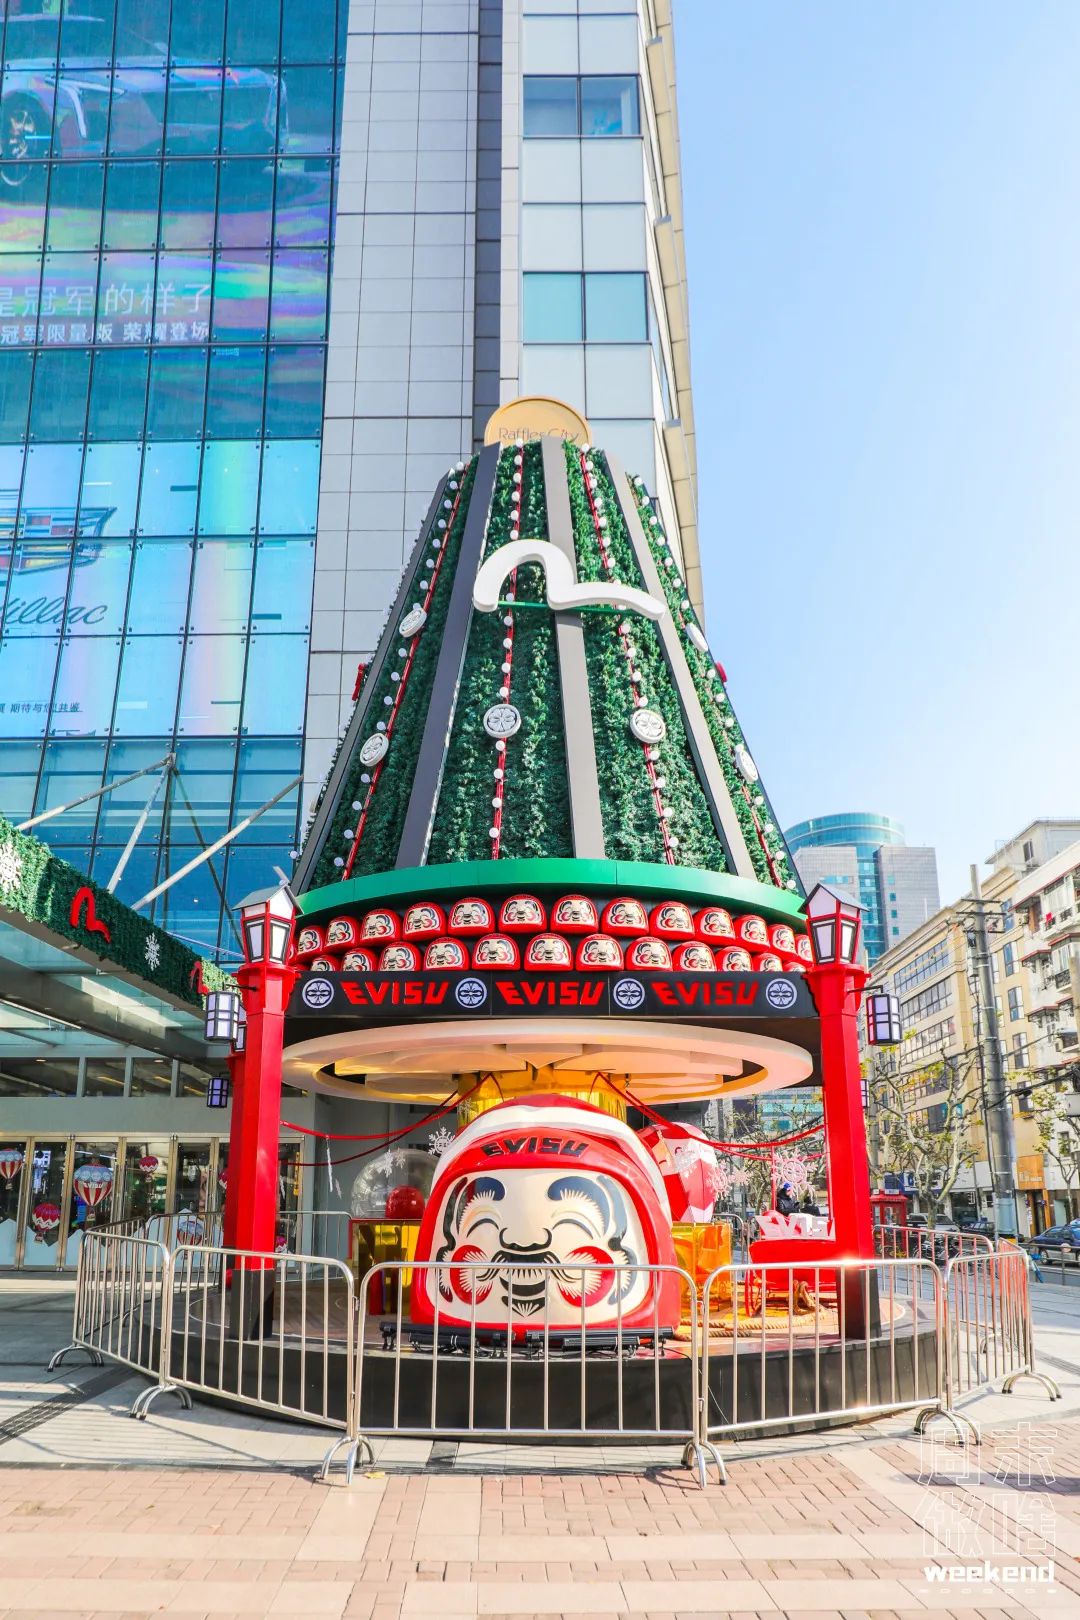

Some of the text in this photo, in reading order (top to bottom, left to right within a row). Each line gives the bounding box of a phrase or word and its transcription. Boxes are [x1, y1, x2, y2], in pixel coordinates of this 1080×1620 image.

[341, 981, 759, 1005] EVISU EVISU EVISU
[481, 1137, 589, 1157] EVISU
